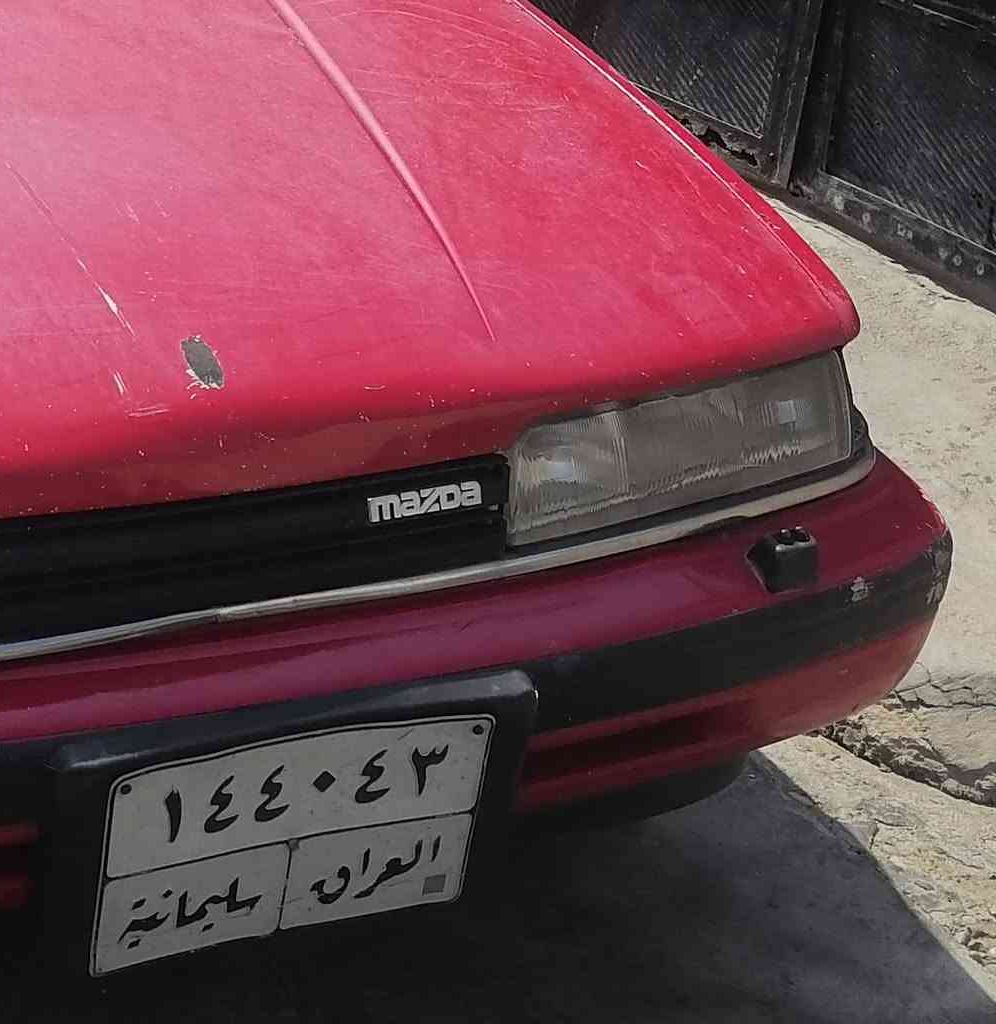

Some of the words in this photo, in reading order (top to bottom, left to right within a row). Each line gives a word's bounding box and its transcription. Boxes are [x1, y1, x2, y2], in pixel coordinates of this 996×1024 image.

[164, 743, 450, 844] ١٤٤٠٤٣
[309, 835, 442, 905] العراق
[117, 877, 263, 950] سليمانية
